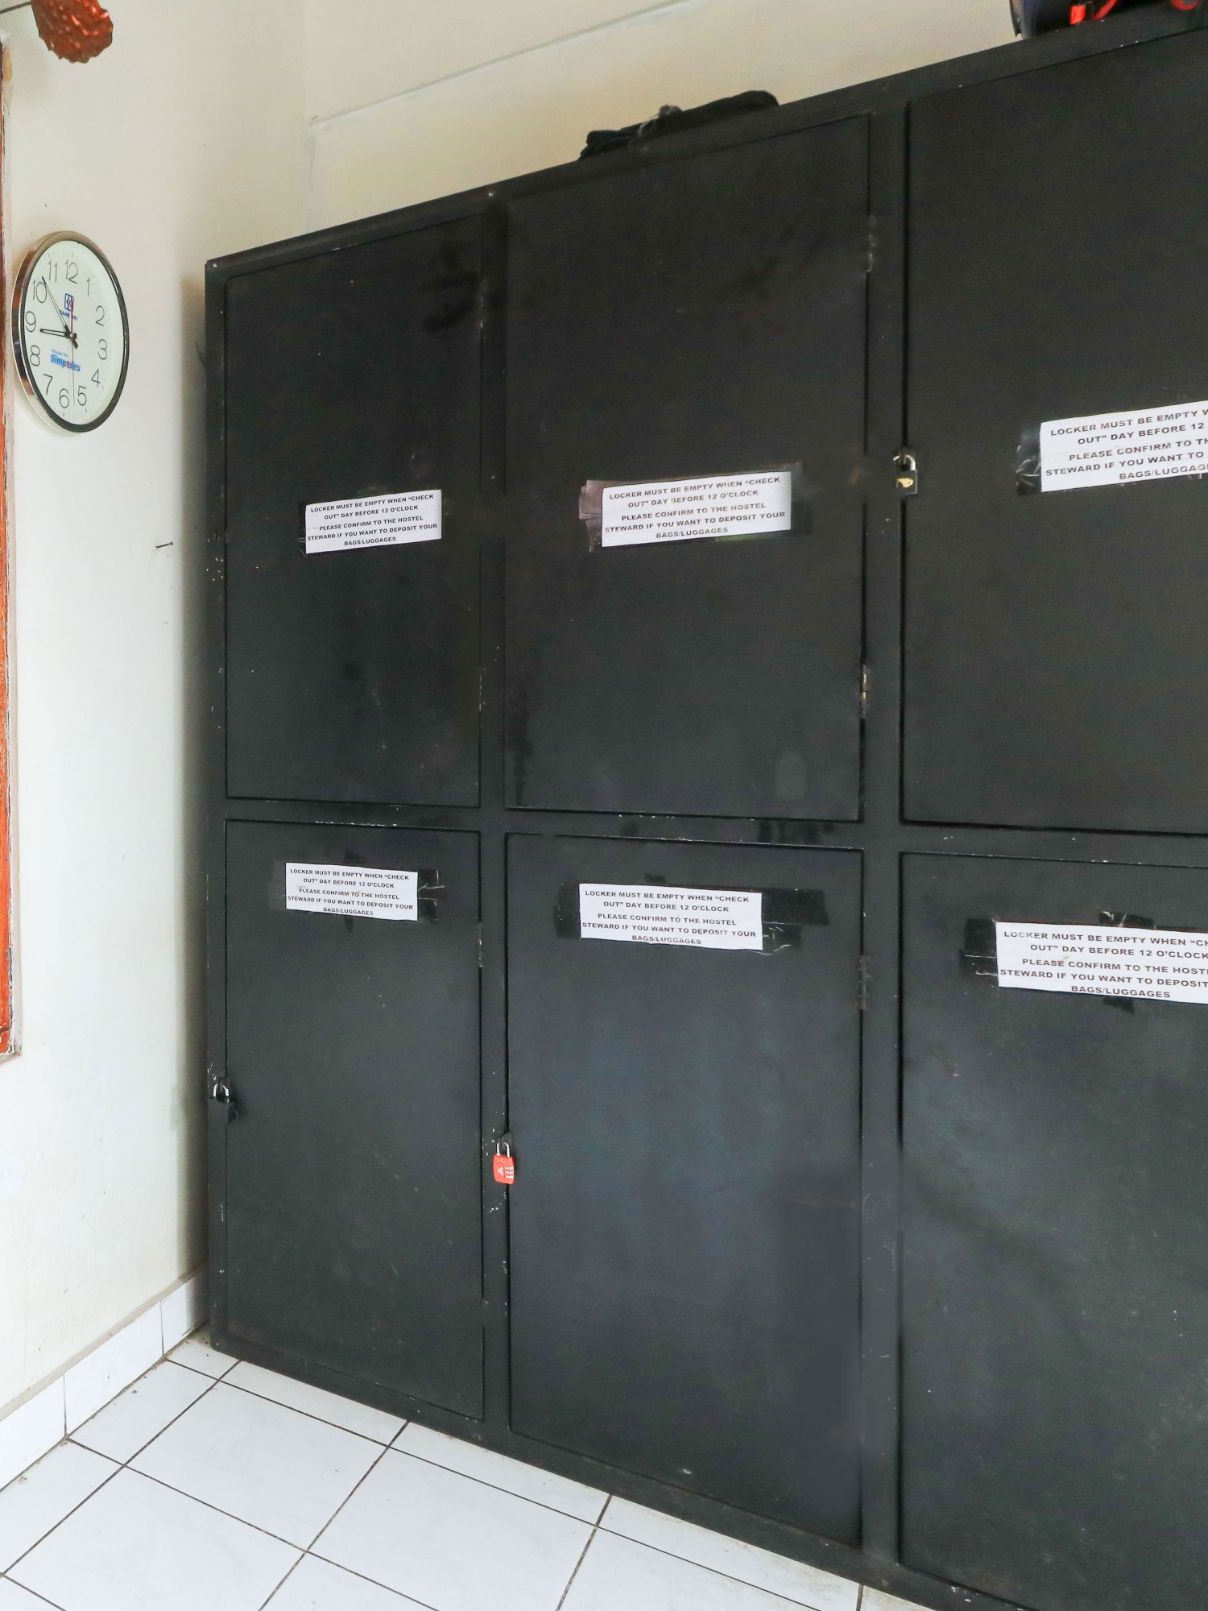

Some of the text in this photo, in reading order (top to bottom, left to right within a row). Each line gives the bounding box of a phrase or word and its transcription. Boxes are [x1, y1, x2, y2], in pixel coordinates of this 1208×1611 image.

[48, 261, 58, 282] 11
[65, 260, 78, 284] 12
[33, 279, 47, 303] 10
[87, 278, 90, 296] 1
[25, 311, 36, 332] 9
[96, 305, 105, 326] 2
[30, 345, 40, 366] 8
[98, 339, 107, 360] 3
[43, 374, 53, 395] 7
[91, 369, 101, 388] 4
[59, 388, 69, 408] 6
[77, 385, 87, 406] 5
[1051, 424, 1097, 436] LOCKER
[1100, 419, 1133, 430] MUST
[1138, 416, 1152, 424] BE
[1157, 410, 1198, 421] EMPTY
[1111, 432, 1134, 441] DAY
[1138, 425, 1186, 437] BEFORE
[1192, 422, 1204, 430] 12
[1069, 450, 1112, 461] PLEASE
[1117, 442, 1171, 455] CONFIRM
[1046, 464, 1100, 476] STEWARD
[1119, 459, 1144, 468] YOU
[1148, 454, 1183, 464] WANT
[1119, 463, 1208, 480] BAGS/LUGGAG
[609, 491, 642, 500] LOCKER
[644, 488, 668, 496] MUST
[684, 483, 714, 492] EMPTY
[716, 480, 742, 488] WHEN
[720, 490, 759, 499] O'CLOCK
[621, 512, 653, 521] PLEASE
[655, 509, 694, 518] CONFIRM
[731, 503, 766, 511] HOSTEL
[605, 524, 644, 532] STEWARD
[676, 518, 701, 526] WANT
[718, 514, 757, 523] DEPOSIT
[1004, 931, 1048, 939] LOCKER
[1106, 936, 1146, 944] EMPTY
[1150, 937, 1186, 946] WHEN
[1089, 947, 1135, 956] BEFORE
[1156, 950, 1208, 959] O'CLOCK
[1022, 958, 1064, 967] PLEASE
[1068, 961, 1121, 970] CONFIRM
[1146, 965, 1168, 973] THE
[1172, 967, 1208, 975] HOST
[1000, 969, 1053, 978] STEWARD
[1071, 973, 1095, 981] YOU
[1099, 975, 1132, 983] WANT
[1157, 978, 1208, 987] DEPOSIT
